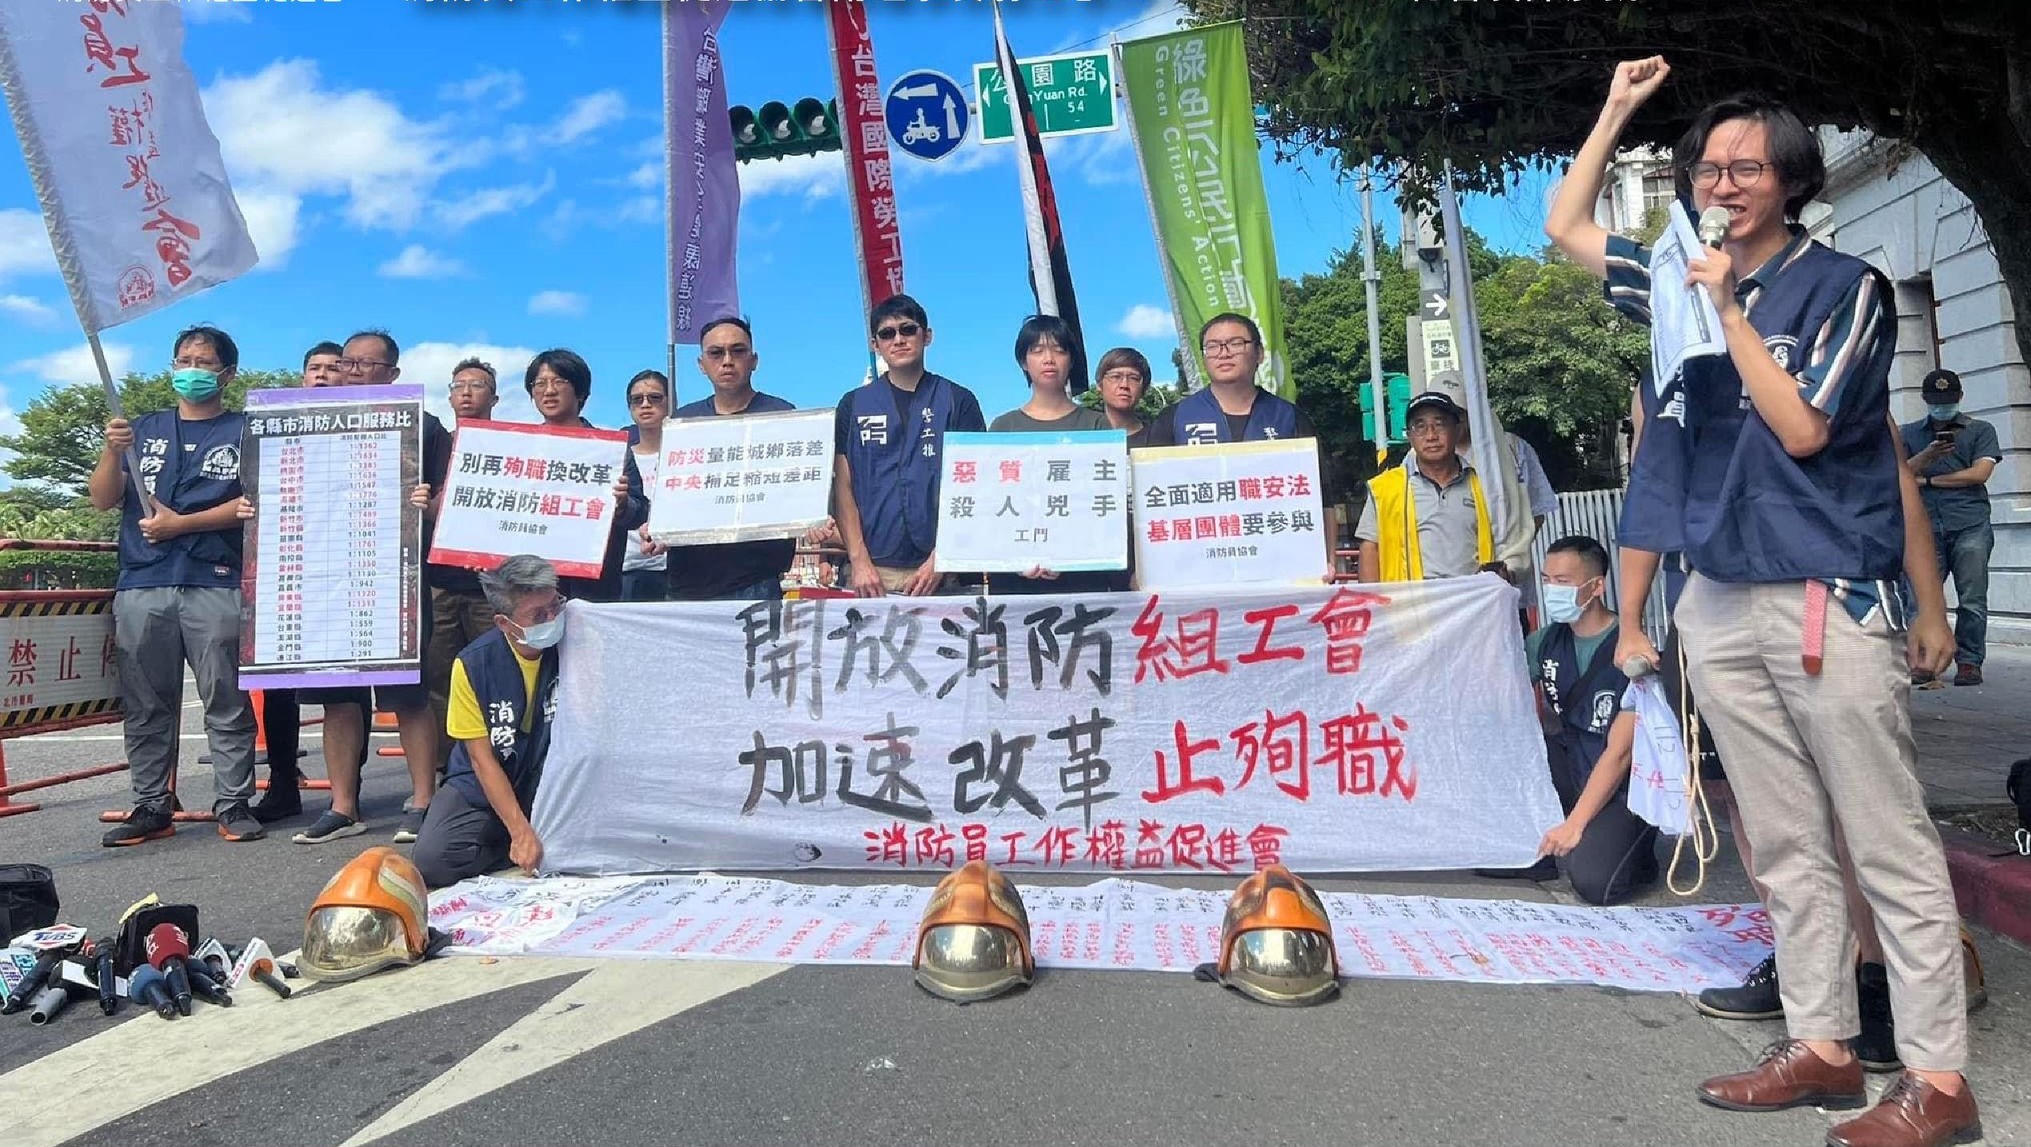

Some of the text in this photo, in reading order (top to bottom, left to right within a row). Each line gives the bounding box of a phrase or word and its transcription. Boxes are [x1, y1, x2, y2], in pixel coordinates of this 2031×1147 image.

[1067, 86, 1088, 98] Rd.
[1155, 44, 1169, 117] Green
[1191, 234, 1220, 308] Action
[250, 411, 412, 435] 各縣市消防人口服務比
[459, 452, 613, 486] 別再殉職換改革
[952, 459, 1117, 484] 惡質雇主
[452, 485, 607, 520] 開放消防組工會
[950, 494, 1117, 519] 殺人兇手
[1144, 473, 1311, 508] 全面適用職安法
[498, 519, 548, 535] 消防員協會
[1147, 509, 1315, 543] 基層團體要參與
[1205, 545, 1259, 559] 消防員協會
[735, 586, 1392, 721] 開放消防組工會
[737, 701, 1419, 835] 加速改革止殉職
[863, 819, 1290, 873] 消防員工作權益促進會
